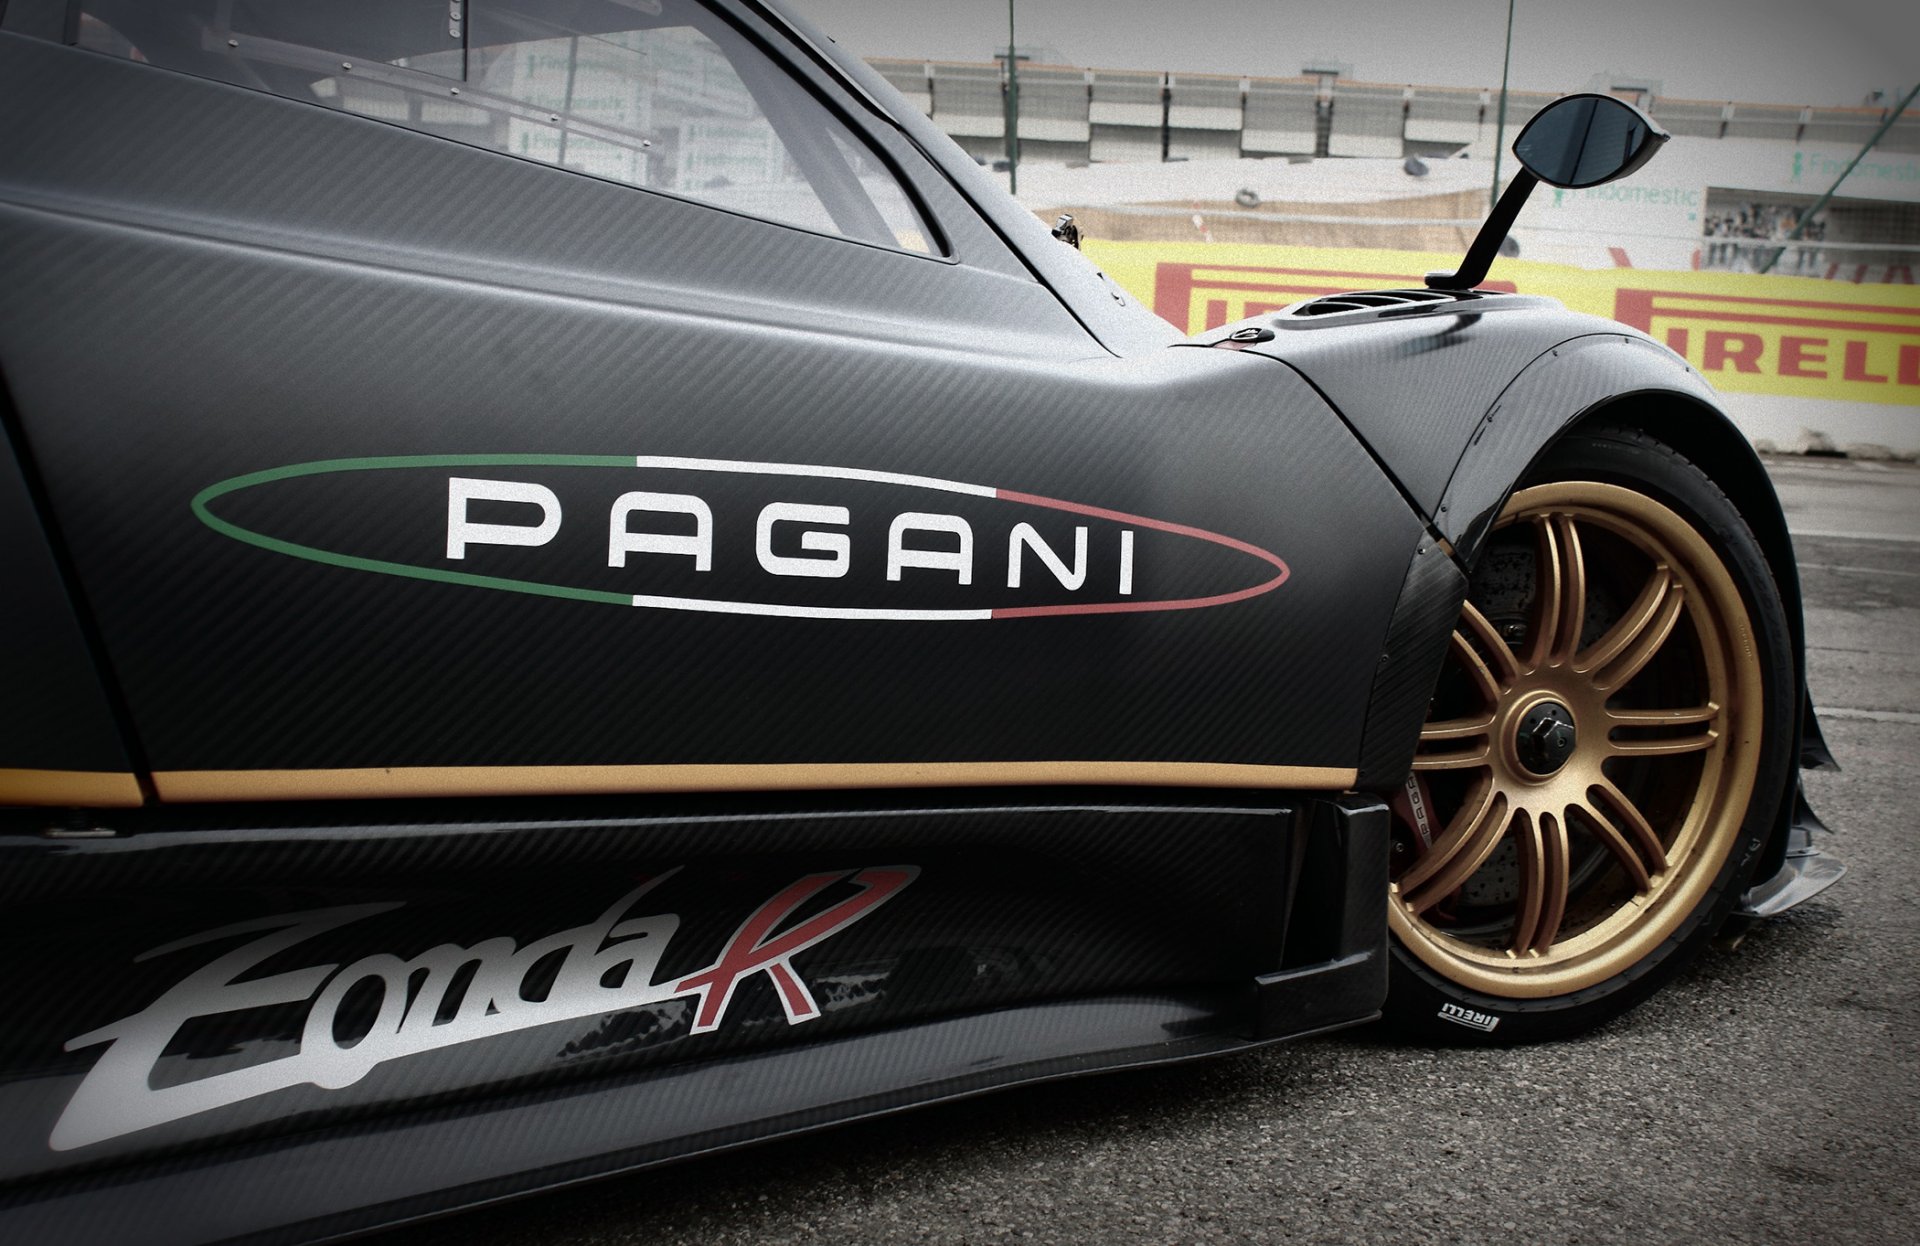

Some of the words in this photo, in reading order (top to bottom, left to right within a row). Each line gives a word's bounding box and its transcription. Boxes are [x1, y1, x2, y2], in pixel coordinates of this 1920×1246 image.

[446, 477, 1134, 595] PAGANI
[49, 864, 682, 1151] Zonda
[673, 864, 922, 1036] R
[1438, 1002, 1500, 1032] PIRELLI
